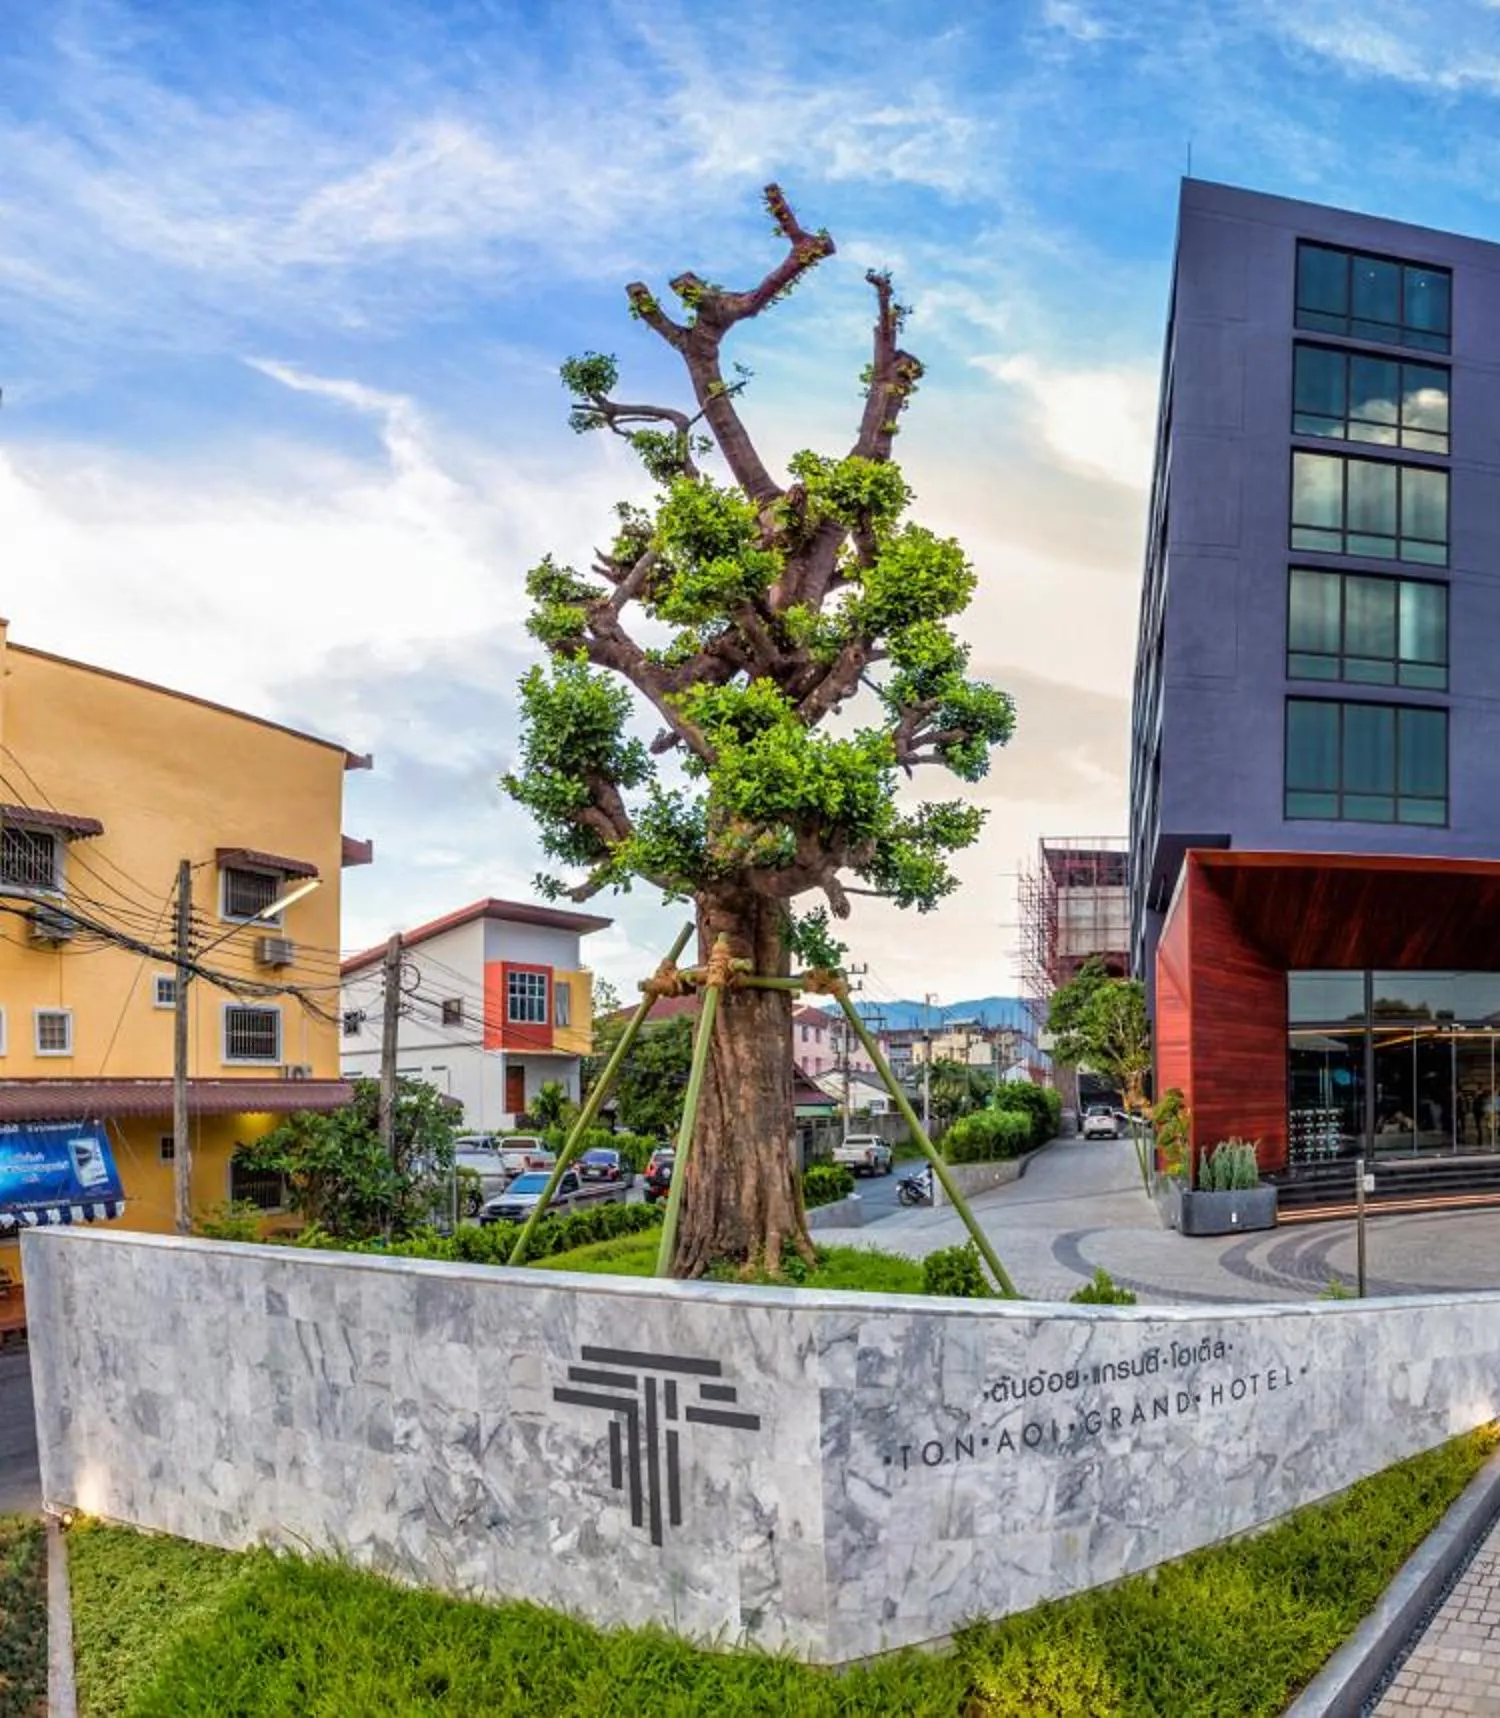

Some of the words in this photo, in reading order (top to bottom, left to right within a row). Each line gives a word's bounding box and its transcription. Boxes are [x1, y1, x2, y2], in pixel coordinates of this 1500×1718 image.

[900, 1434, 975, 1471] TON
[996, 1419, 1059, 1454] AOI
[1085, 1391, 1190, 1434] GRAND
[1211, 1366, 1293, 1406] HOTEL
